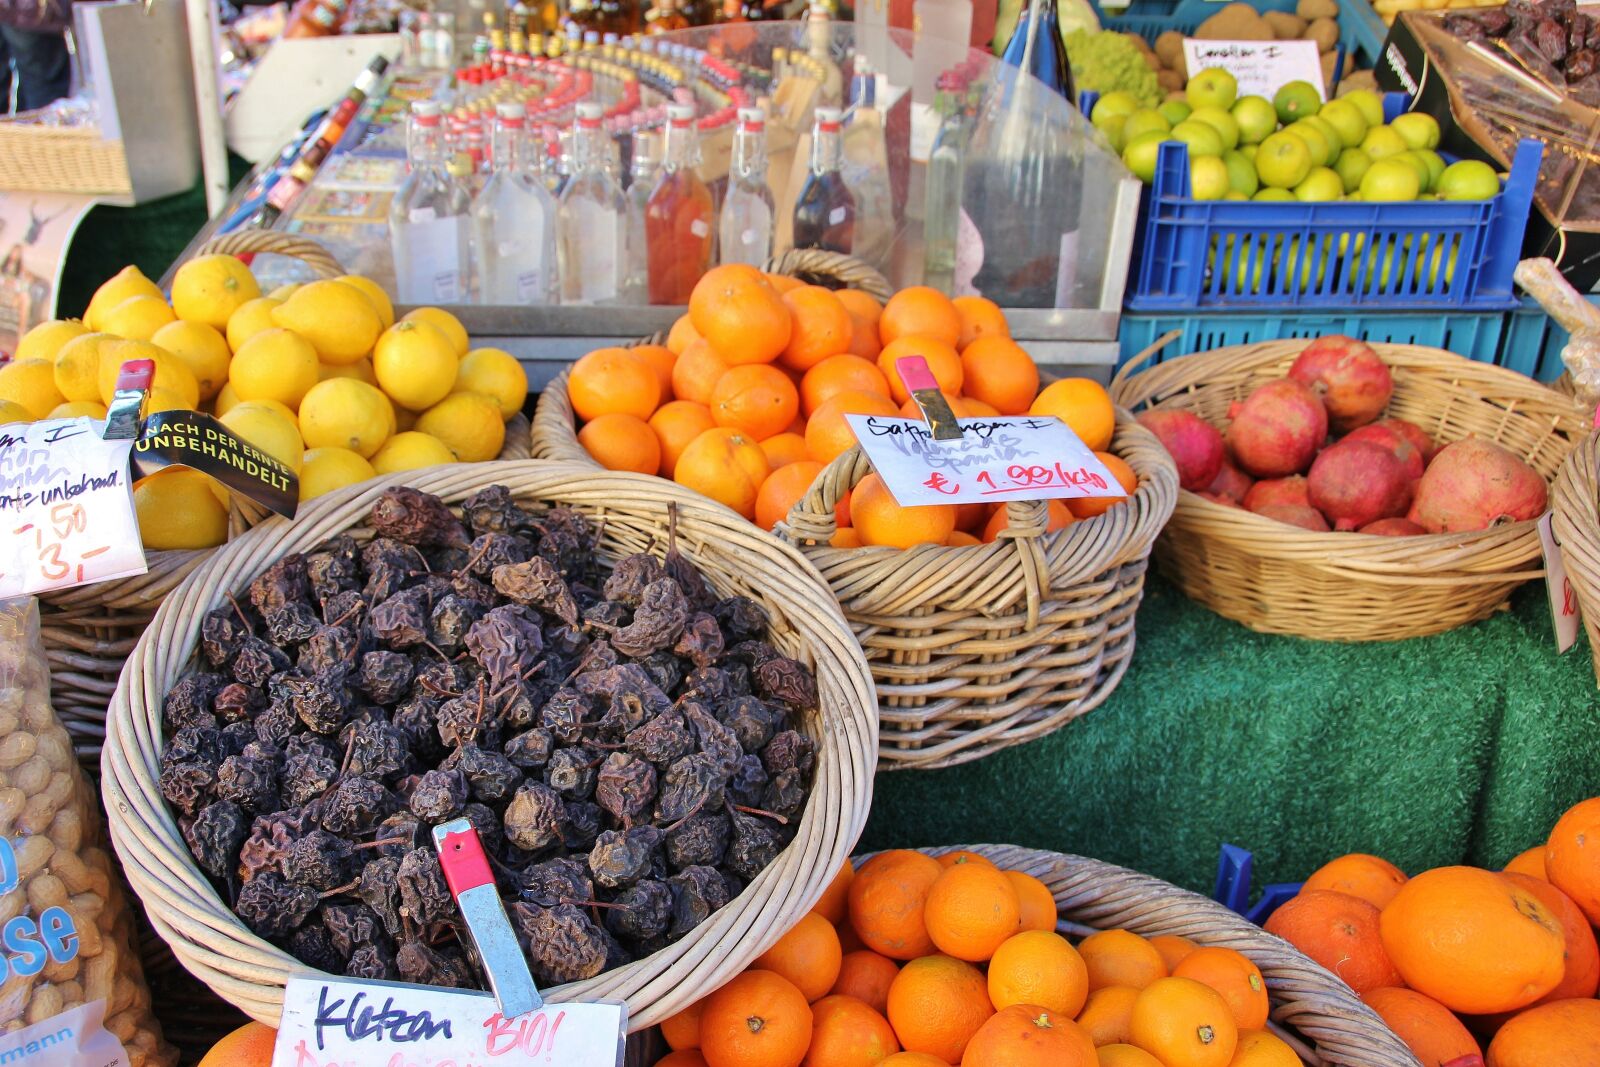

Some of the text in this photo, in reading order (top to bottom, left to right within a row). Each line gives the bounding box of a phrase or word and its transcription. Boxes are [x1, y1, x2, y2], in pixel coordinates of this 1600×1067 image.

[135, 435, 290, 492] UNBEHANDELT
[145, 423, 289, 476] NACH DER ERNTE
[923, 472, 960, 495] €
[0, 906, 79, 986] se
